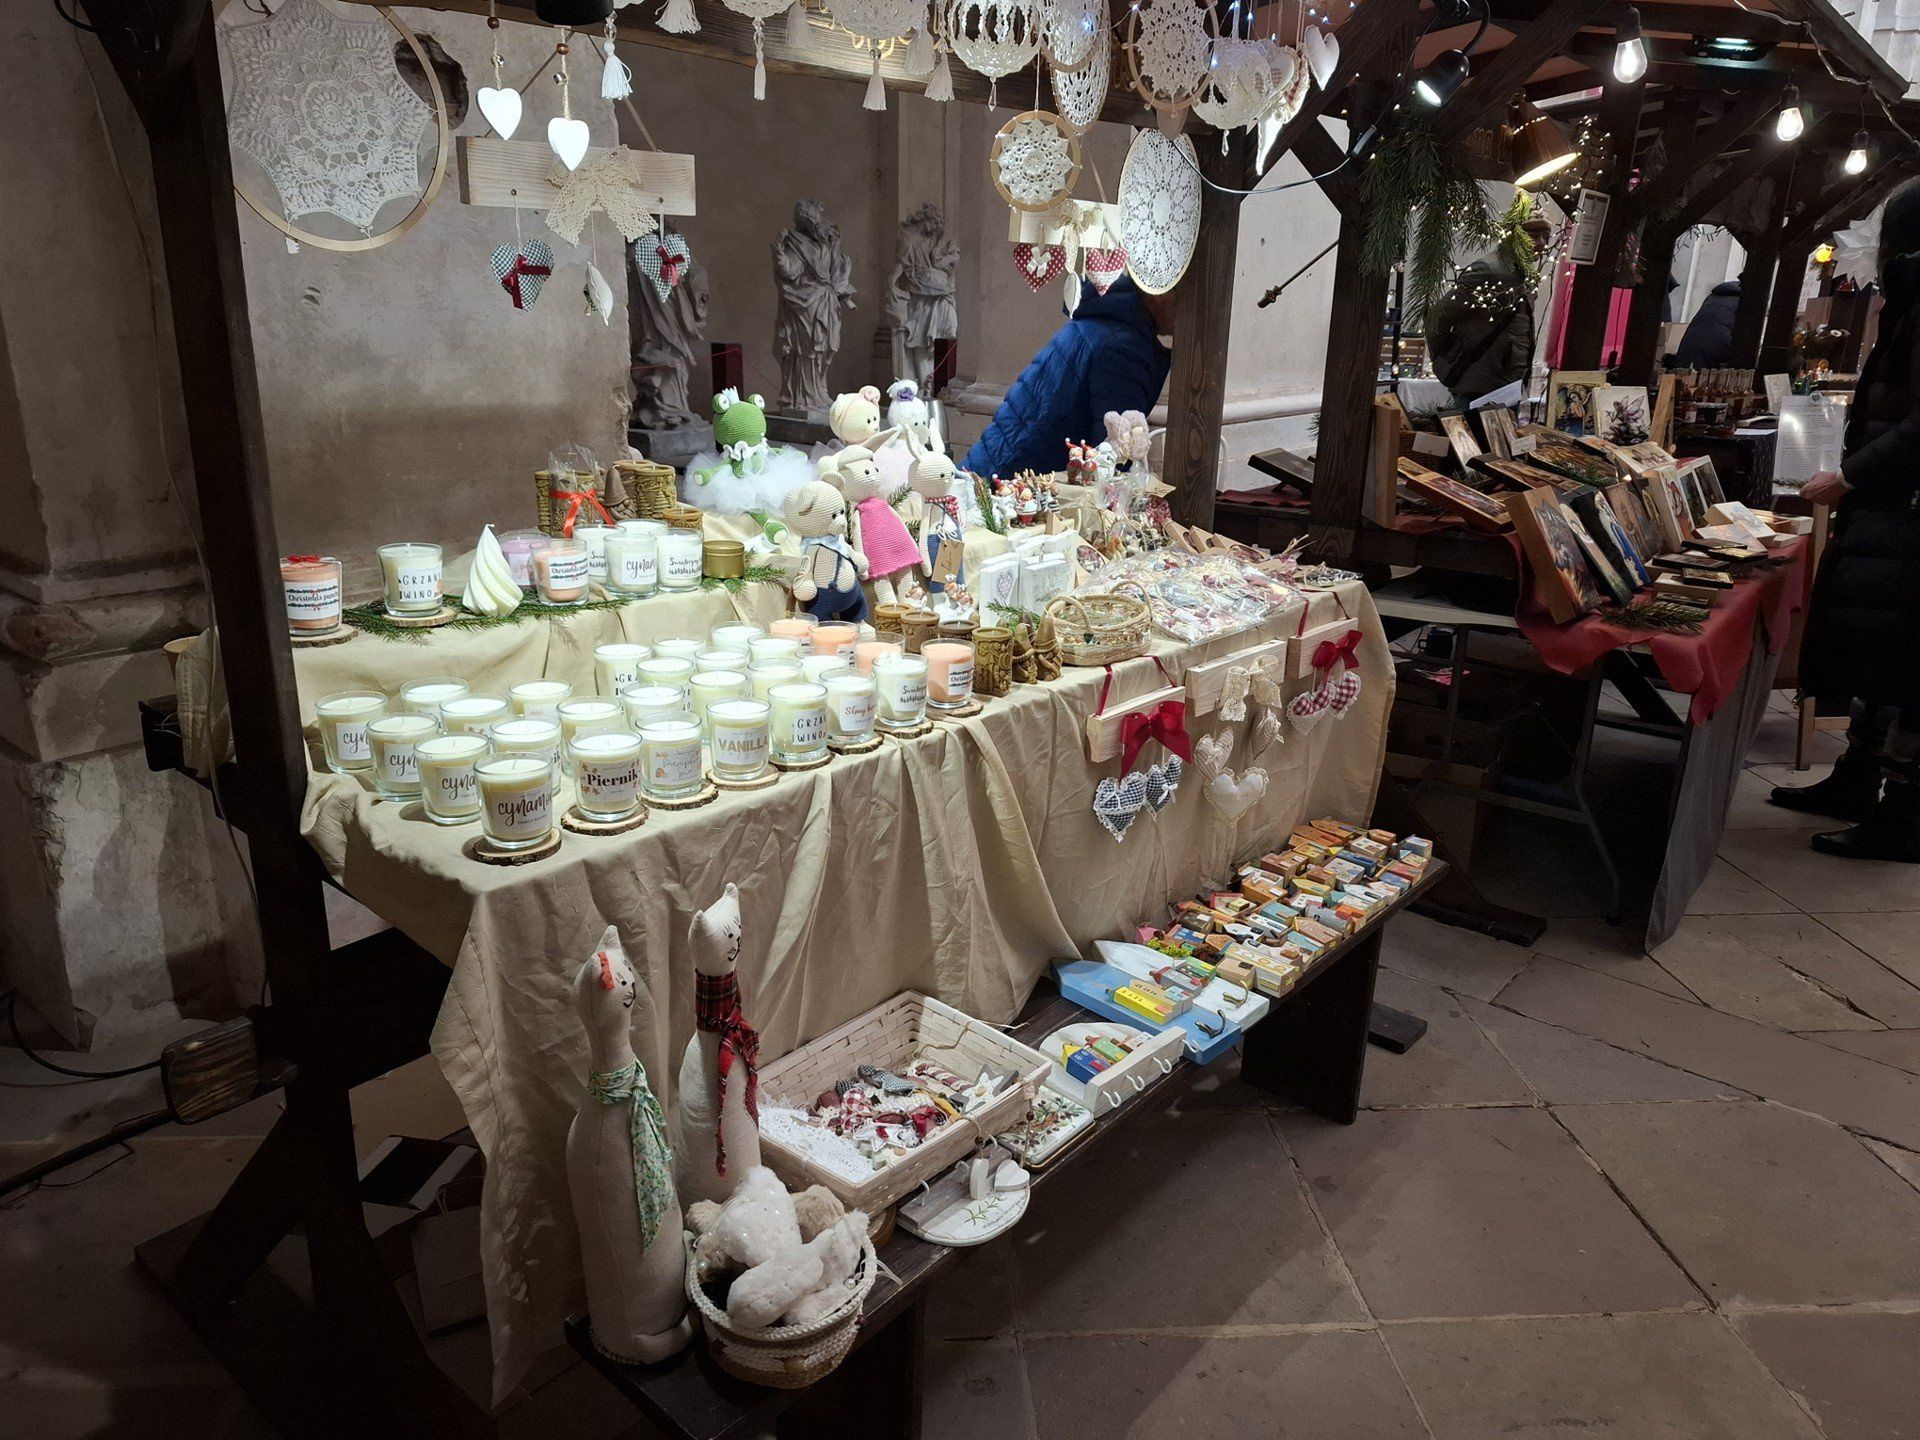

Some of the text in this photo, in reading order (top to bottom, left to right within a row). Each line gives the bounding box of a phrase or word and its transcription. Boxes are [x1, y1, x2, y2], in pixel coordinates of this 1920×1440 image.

[403, 589, 432, 599] WINO
[797, 730, 823, 742] WINO
[718, 735, 768, 752] VANILLA
[587, 769, 638, 786] Piernik
